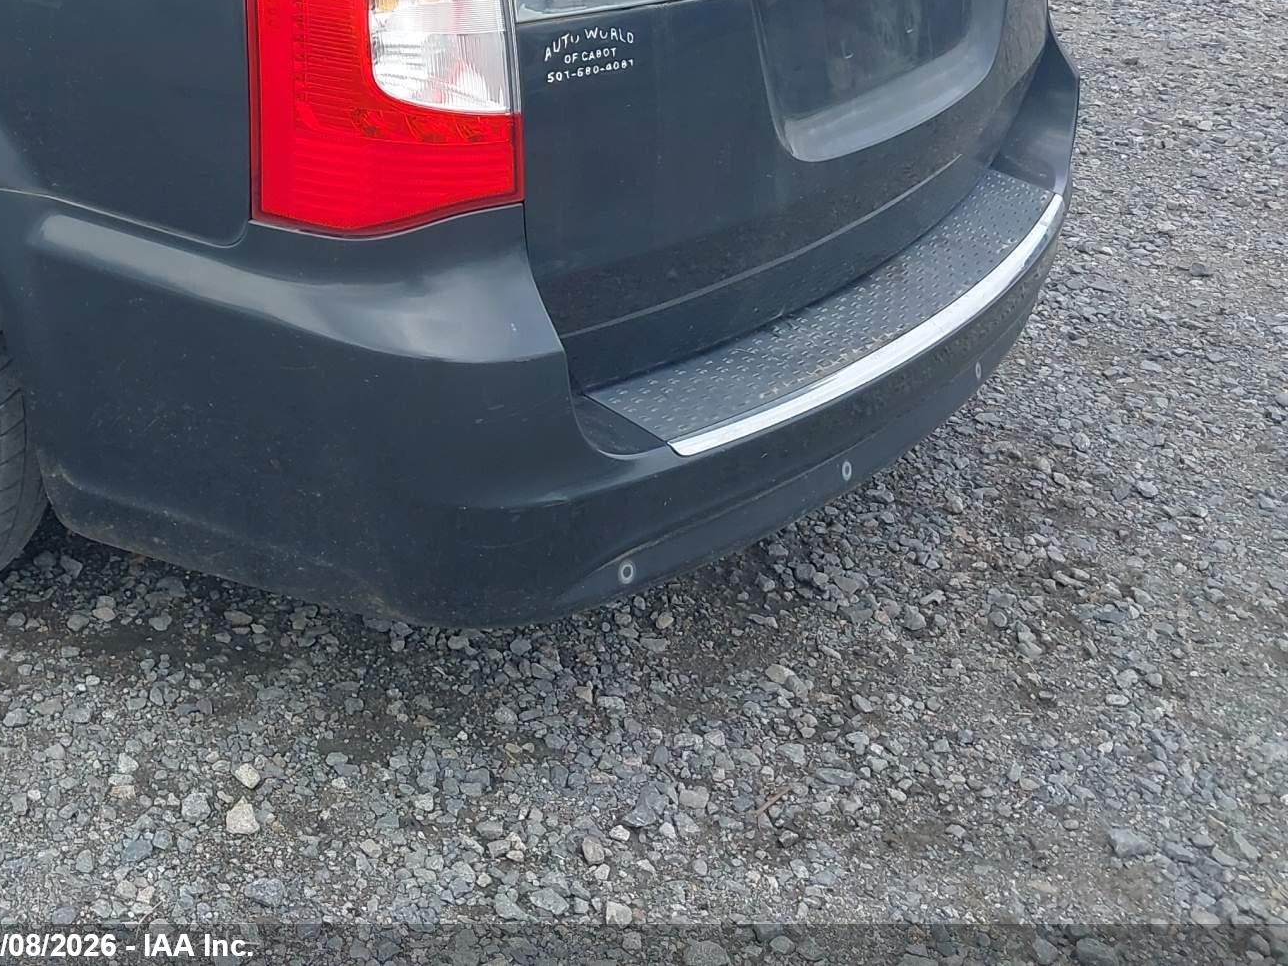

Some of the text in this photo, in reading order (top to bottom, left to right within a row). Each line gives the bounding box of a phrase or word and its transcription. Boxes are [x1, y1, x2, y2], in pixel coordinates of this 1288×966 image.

[544, 27, 634, 62] AUTO WORLD
[564, 47, 617, 64] OF CABOT
